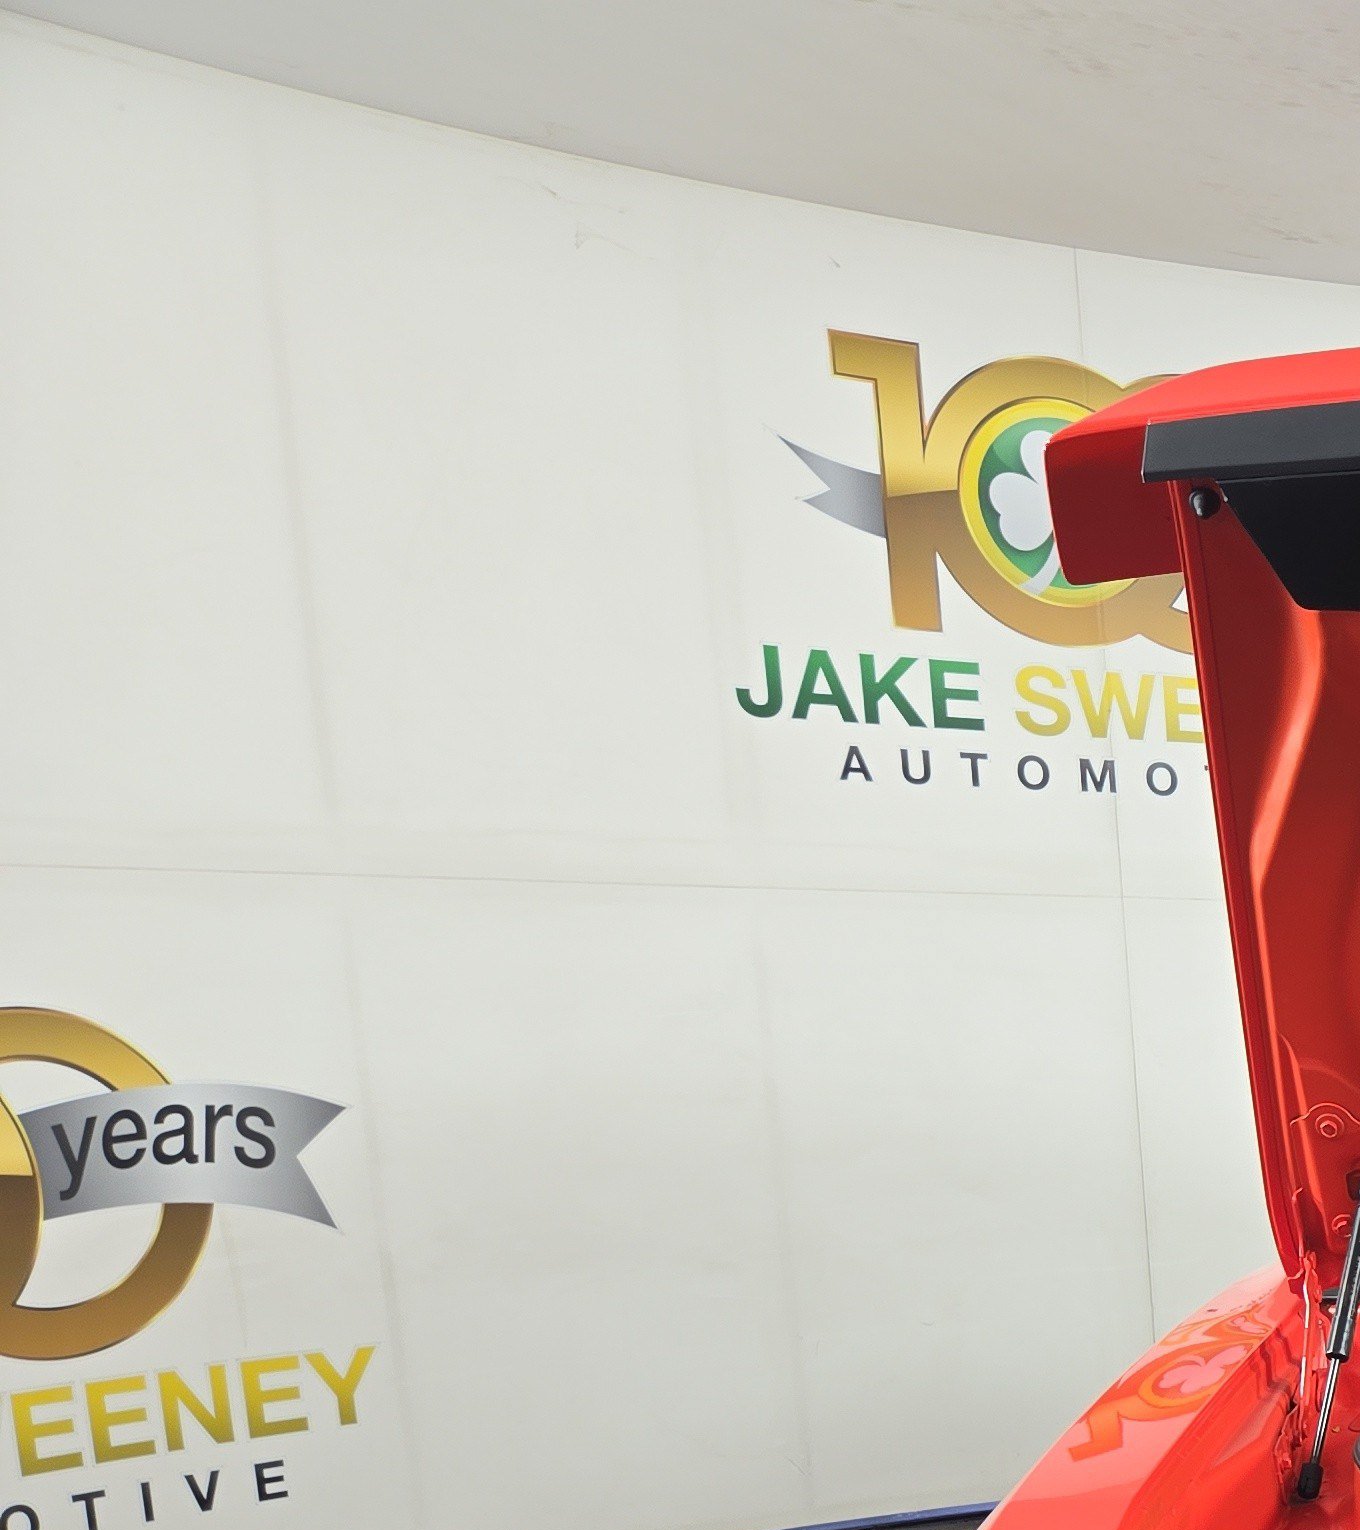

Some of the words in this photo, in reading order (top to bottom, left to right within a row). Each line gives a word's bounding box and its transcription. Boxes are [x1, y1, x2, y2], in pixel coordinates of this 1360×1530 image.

[735, 644, 985, 731] JAKE
[840, 745, 1209, 797] AUTOMO
[51, 1102, 277, 1201] years
[11, 1345, 376, 1477] EENEY
